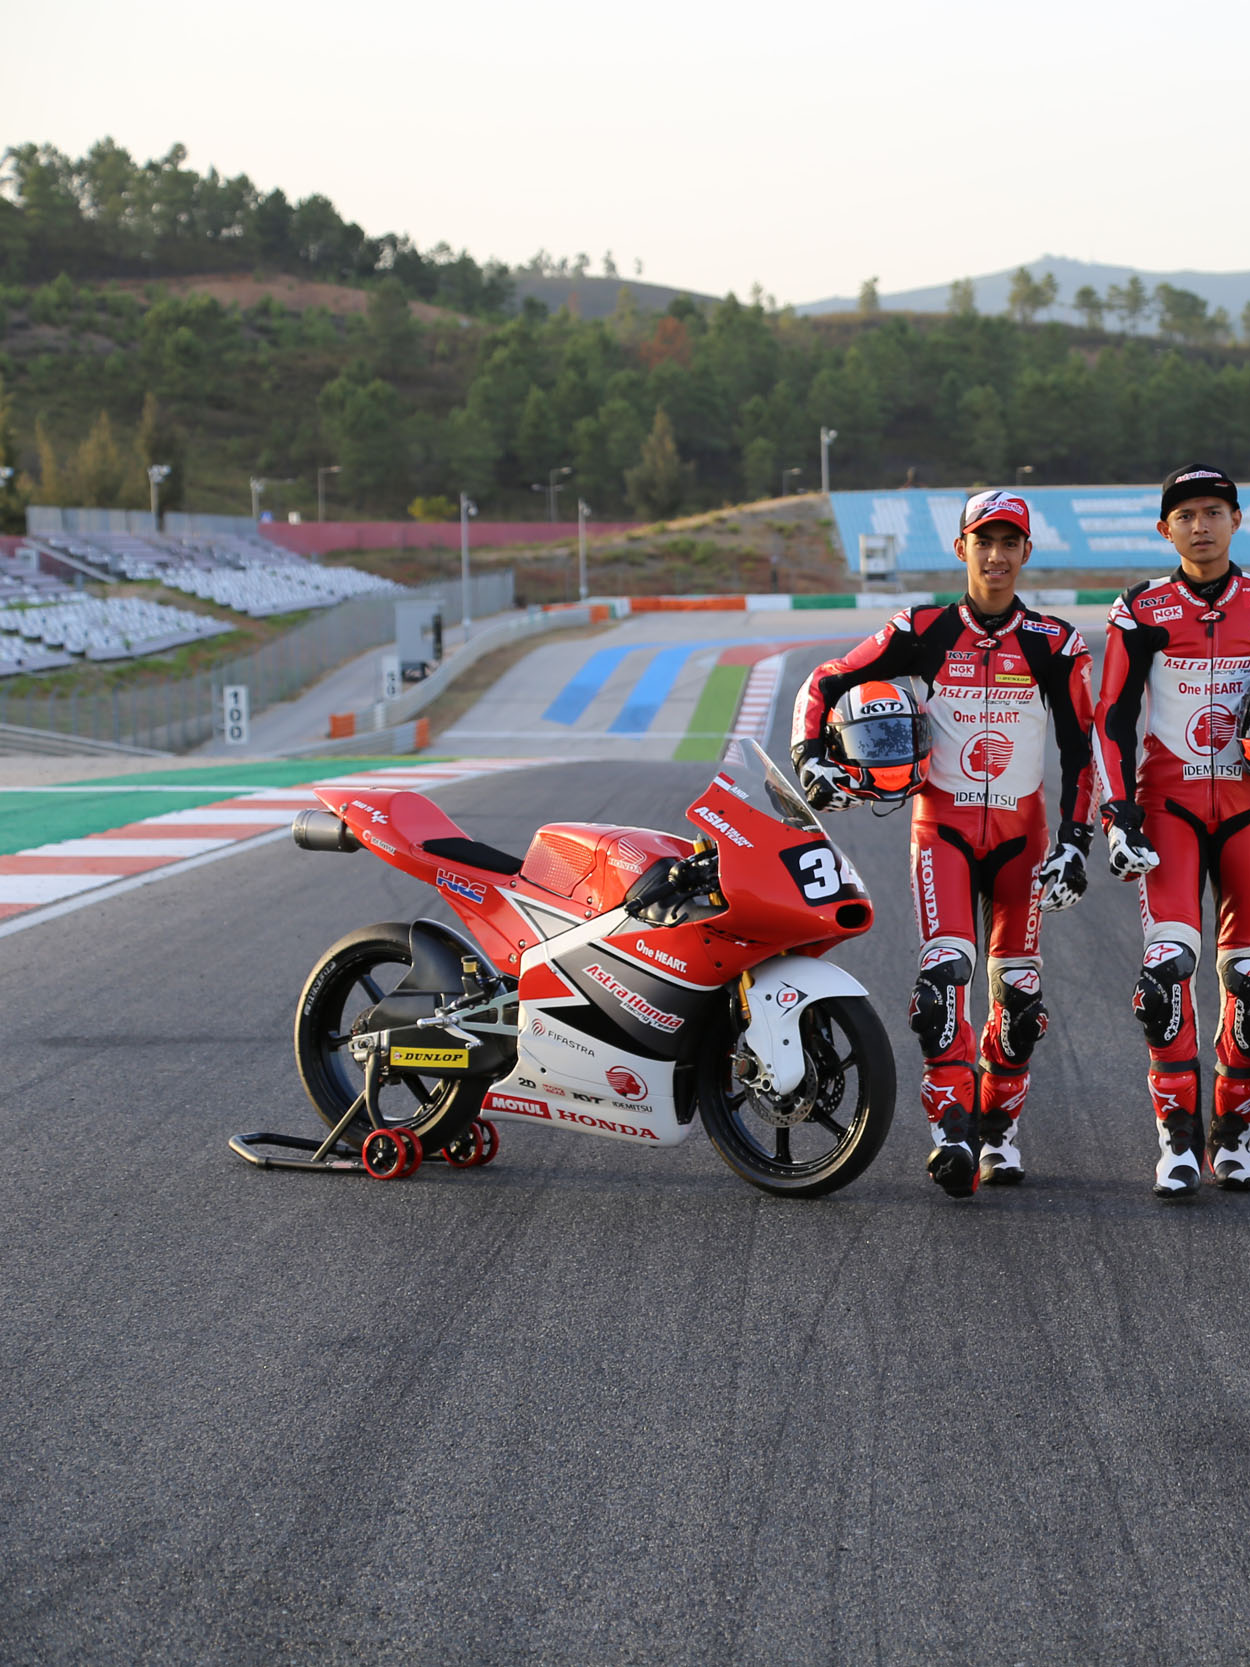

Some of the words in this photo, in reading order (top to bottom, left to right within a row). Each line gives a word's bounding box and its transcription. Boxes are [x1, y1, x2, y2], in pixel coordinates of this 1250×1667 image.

[1155, 607, 1181, 618] NGK
[1164, 659, 1207, 670] Astra
[939, 687, 982, 699] Astra
[987, 689, 1035, 700] Honda
[1179, 682, 1201, 695] One
[1205, 682, 1243, 695] HEART.
[229, 690, 242, 739] 100
[864, 702, 900, 713] KYT
[953, 711, 976, 723] One
[979, 711, 1020, 723] HEART.
[1184, 765, 1241, 777] IDEMITSU
[955, 792, 1016, 807] IDEMITSU
[694, 806, 730, 833] ASIA
[607, 858, 643, 874] HONDA
[436, 868, 487, 903] HRC
[921, 848, 940, 937] HONDA
[636, 939, 653, 957] One
[654, 950, 687, 974] HEART.
[586, 965, 628, 999] Astra
[628, 994, 684, 1027] Honda
[548, 1030, 595, 1057] FIFASTRA
[404, 1052, 463, 1062] DUNLOP
[518, 1077, 536, 1089] 2D
[492, 1097, 544, 1115] MOTUL
[612, 1101, 653, 1113] IDEMITSU
[557, 1109, 660, 1140] HONDA
